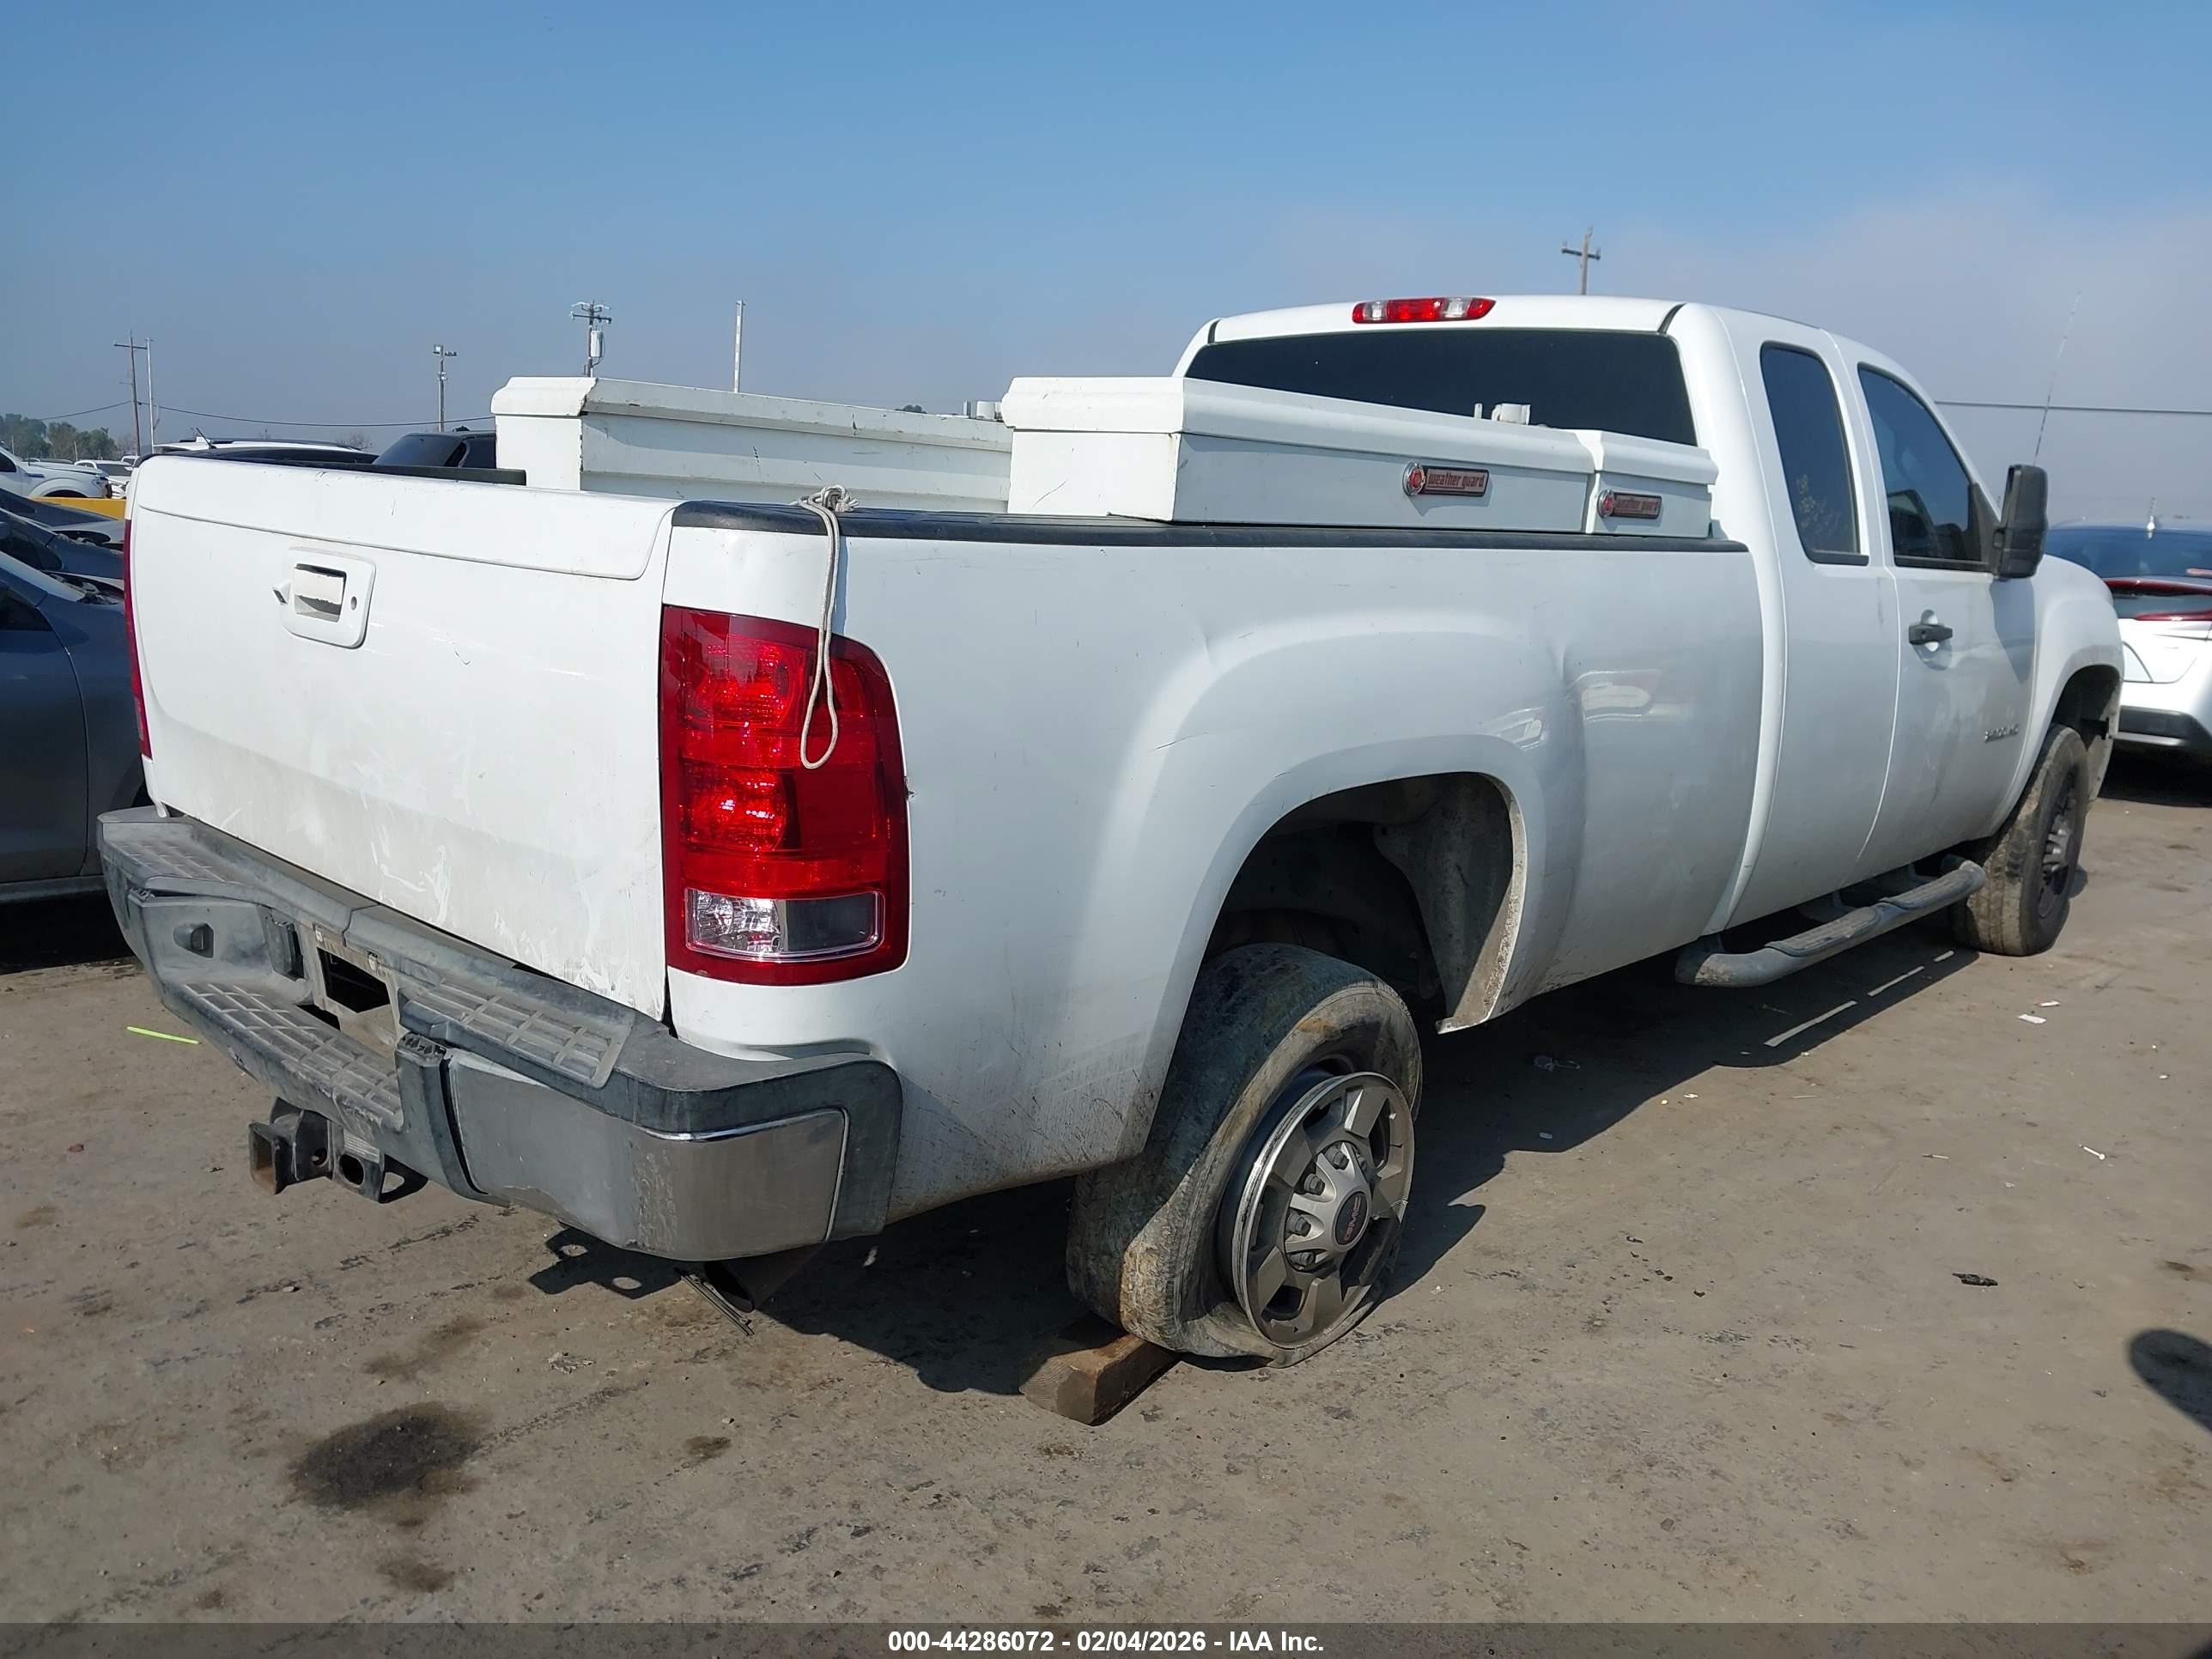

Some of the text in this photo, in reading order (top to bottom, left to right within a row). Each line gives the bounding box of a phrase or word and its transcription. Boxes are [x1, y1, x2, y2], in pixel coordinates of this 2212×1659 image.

[1428, 471, 1486, 489] weather guard
[1344, 1196, 1362, 1241] GMC
